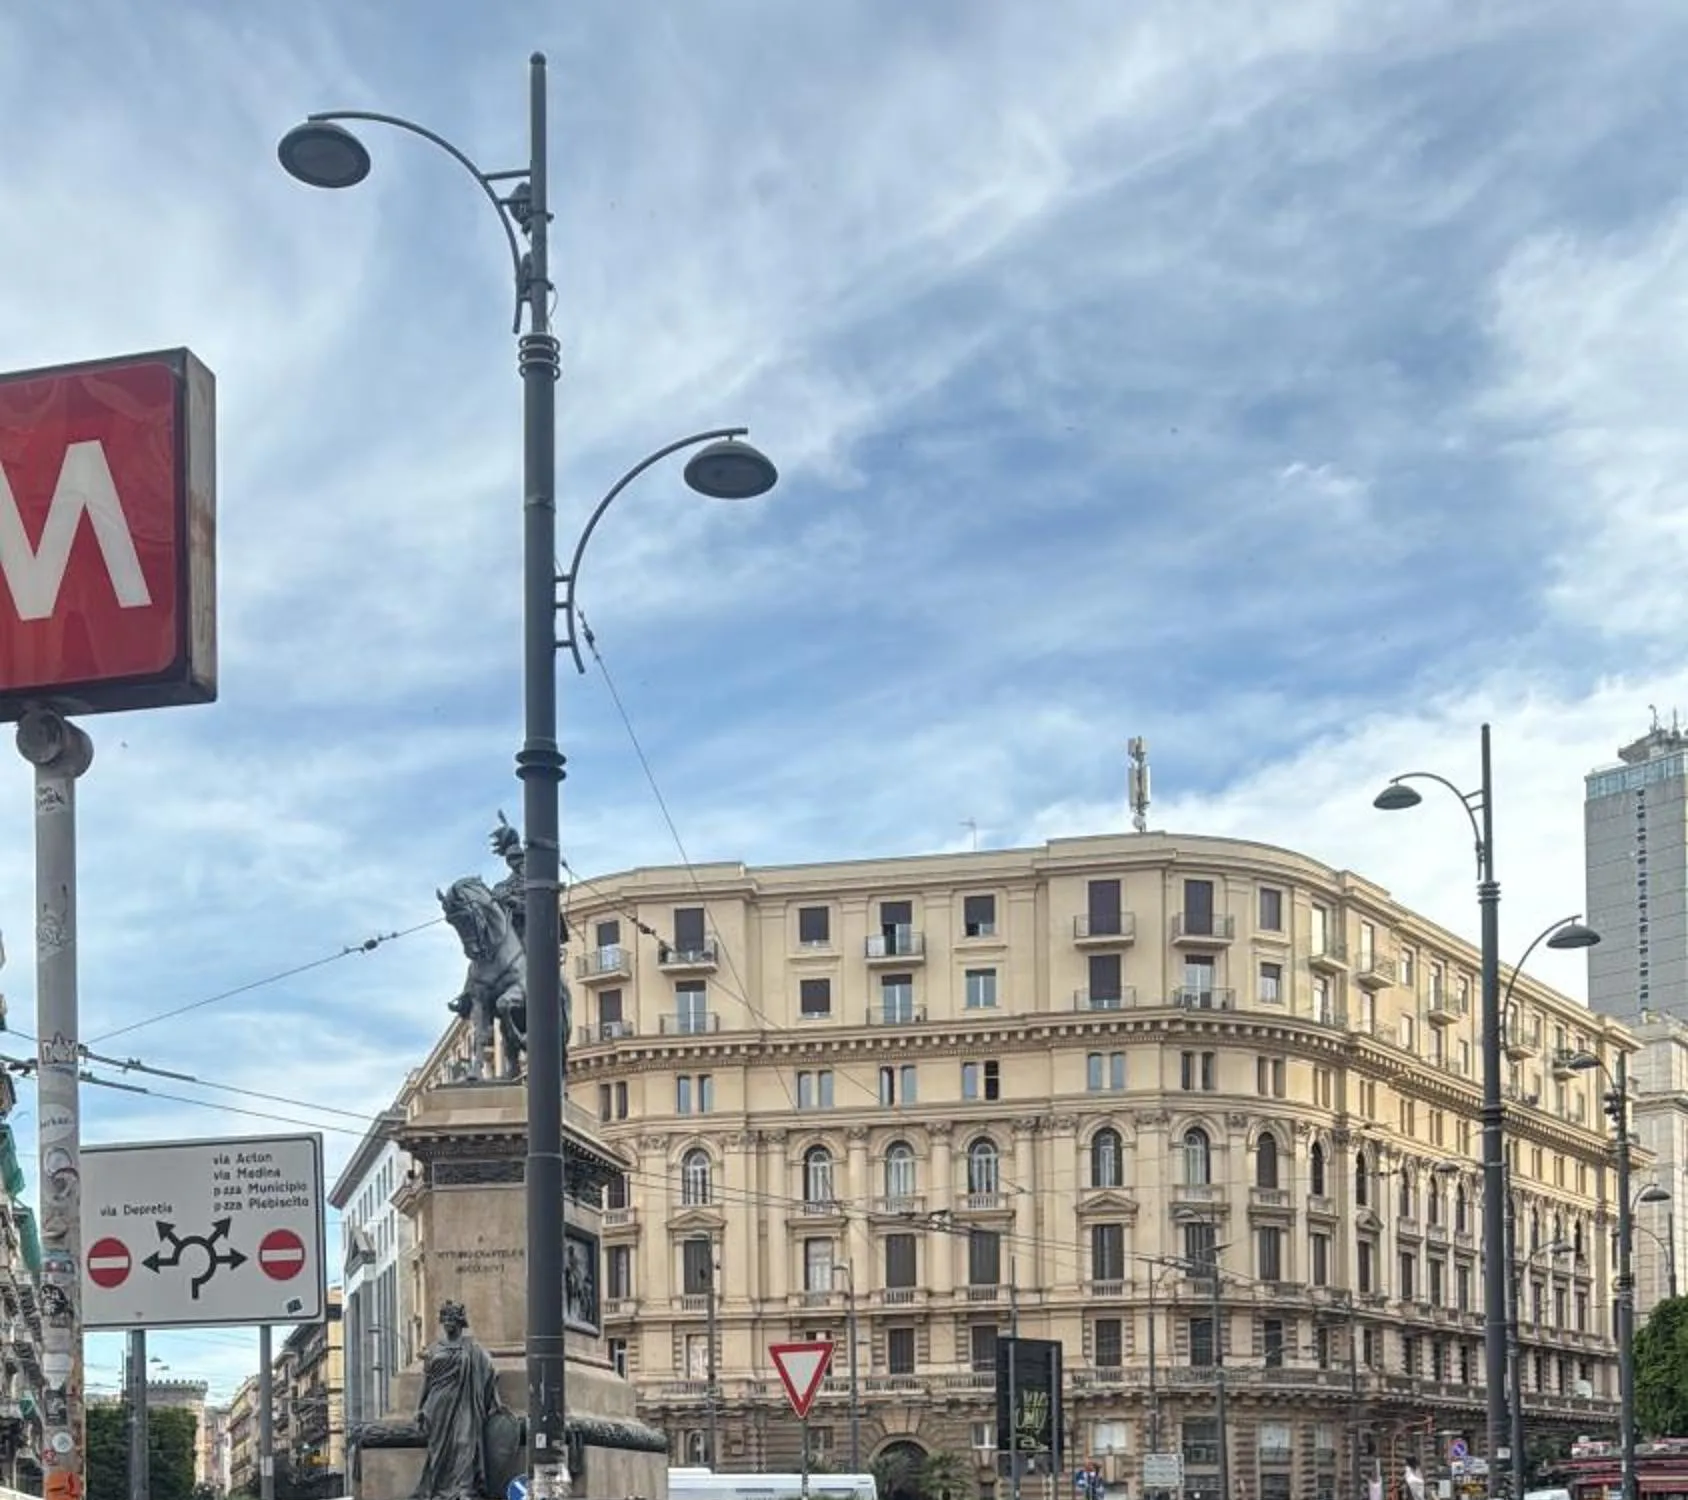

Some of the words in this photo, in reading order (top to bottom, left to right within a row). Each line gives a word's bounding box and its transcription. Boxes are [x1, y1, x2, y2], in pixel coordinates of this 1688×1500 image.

[213, 1153, 230, 1165] via
[236, 1152, 273, 1164] Acton
[213, 1170, 231, 1180] via
[237, 1167, 281, 1179] Medina
[248, 1181, 307, 1194] Municipio
[249, 1196, 309, 1209] Plebiscito
[100, 1205, 116, 1217] via
